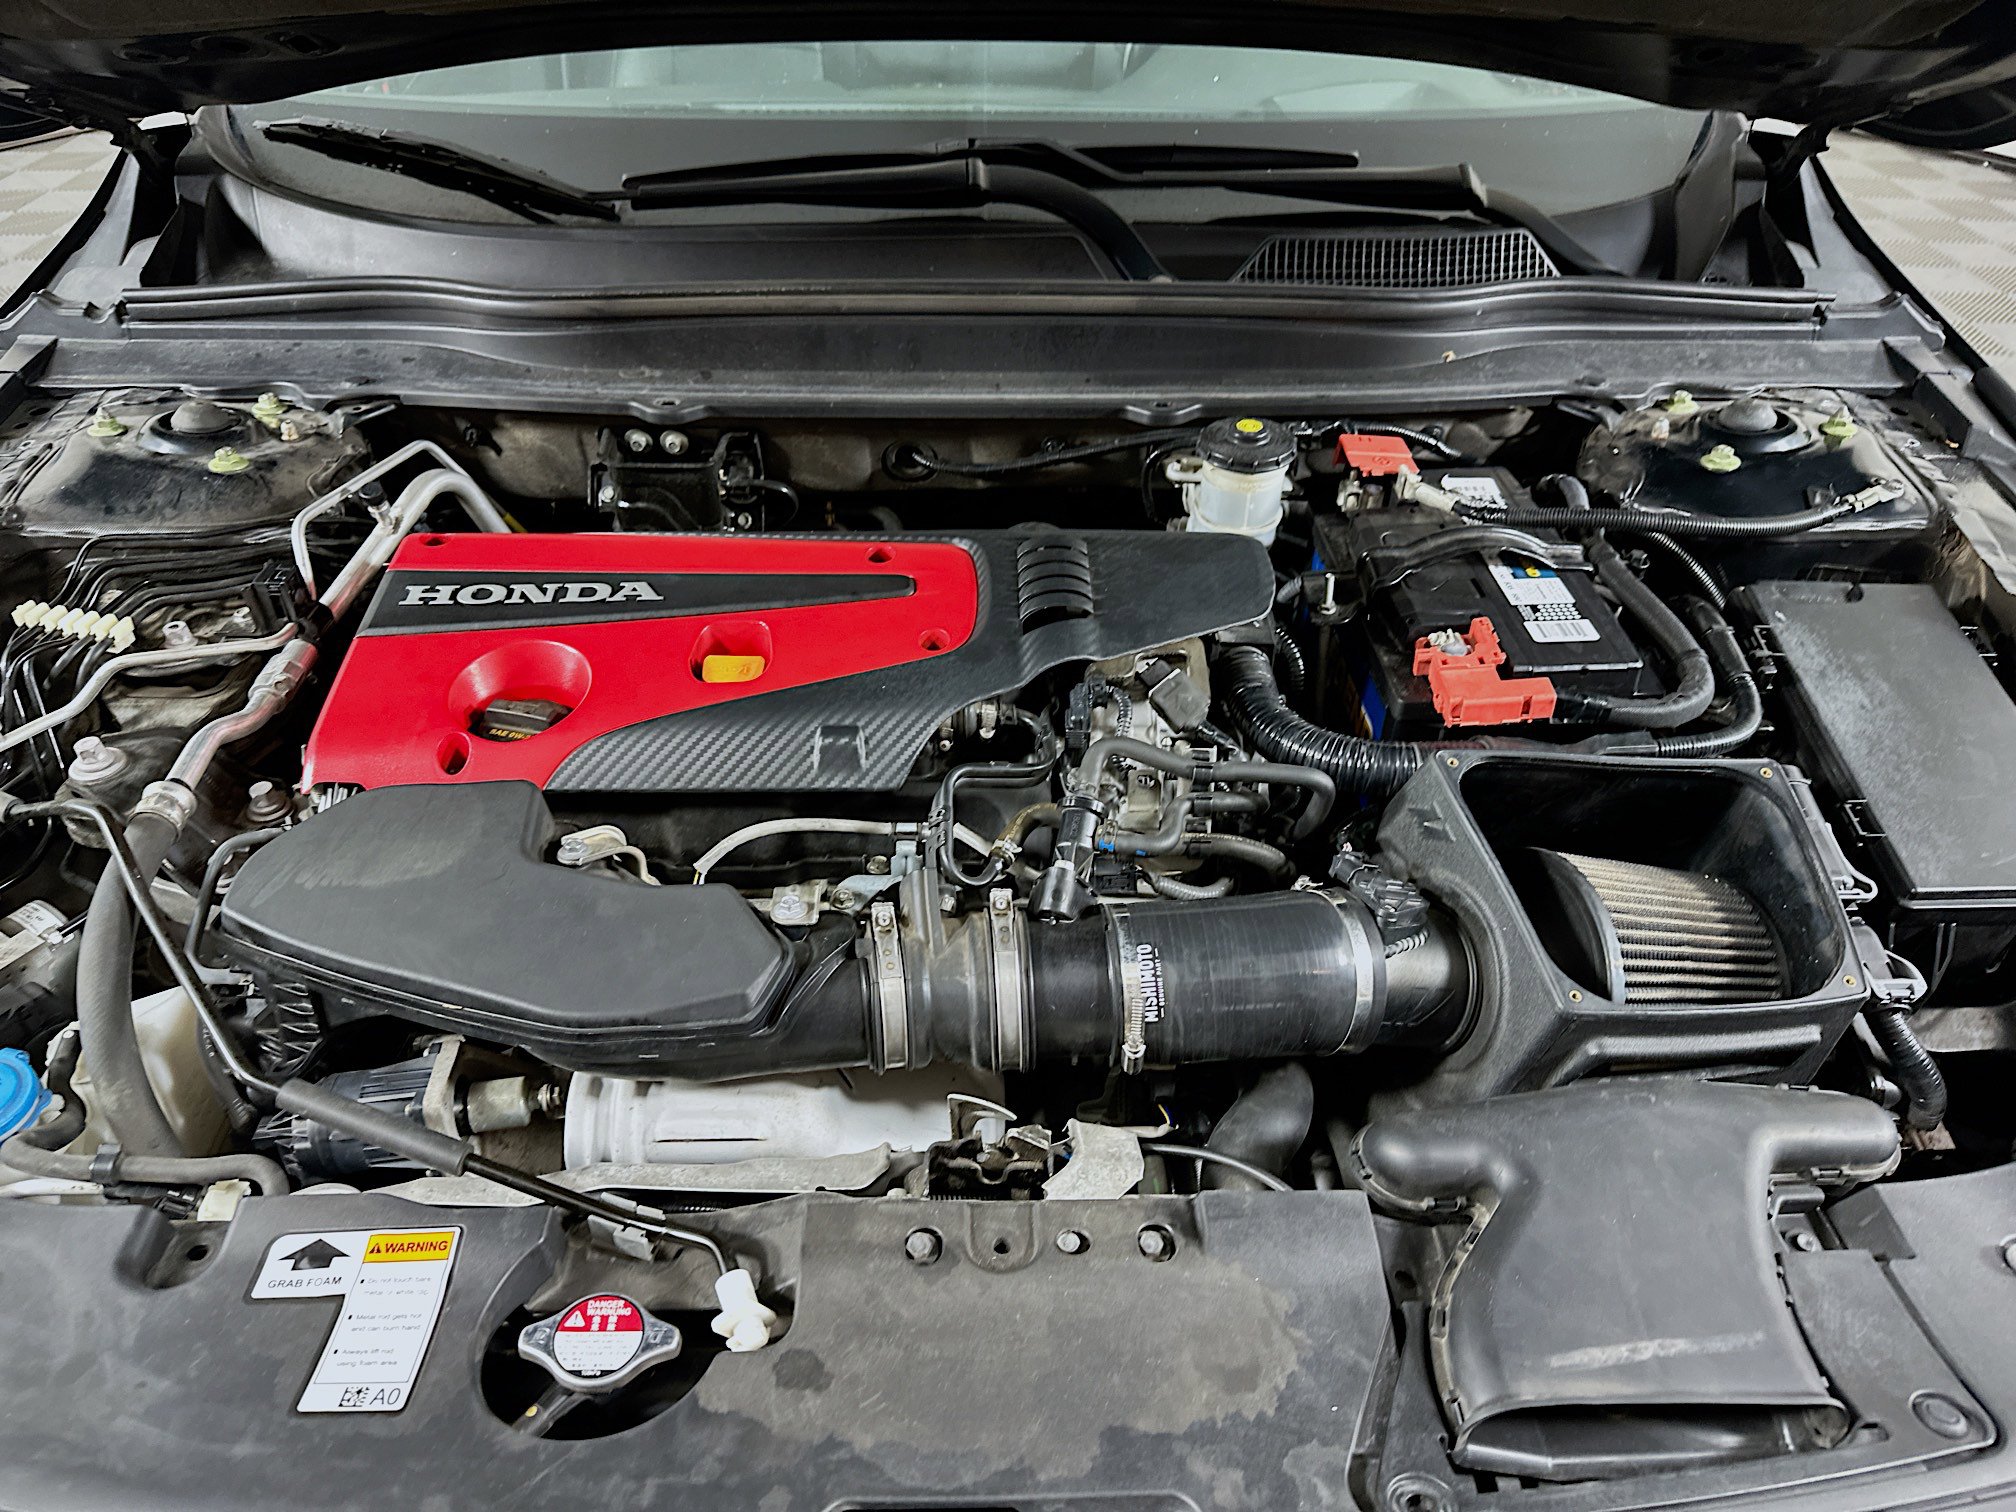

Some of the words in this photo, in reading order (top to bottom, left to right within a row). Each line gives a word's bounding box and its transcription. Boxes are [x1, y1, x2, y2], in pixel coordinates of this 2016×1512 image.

[398, 581, 665, 606] HONDA
[489, 728, 510, 738] SAE
[1154, 959, 1162, 976] PART
[1136, 944, 1159, 1022] MISHIMOTO
[1157, 977, 1165, 1006] GENUINE
[385, 1241, 448, 1254] WARNING
[268, 1278, 303, 1289] GRAB
[306, 1276, 343, 1287] FOAM
[588, 1300, 626, 1308] DANGER
[393, 1313, 407, 1321] gets
[587, 1307, 632, 1316] WARNING
